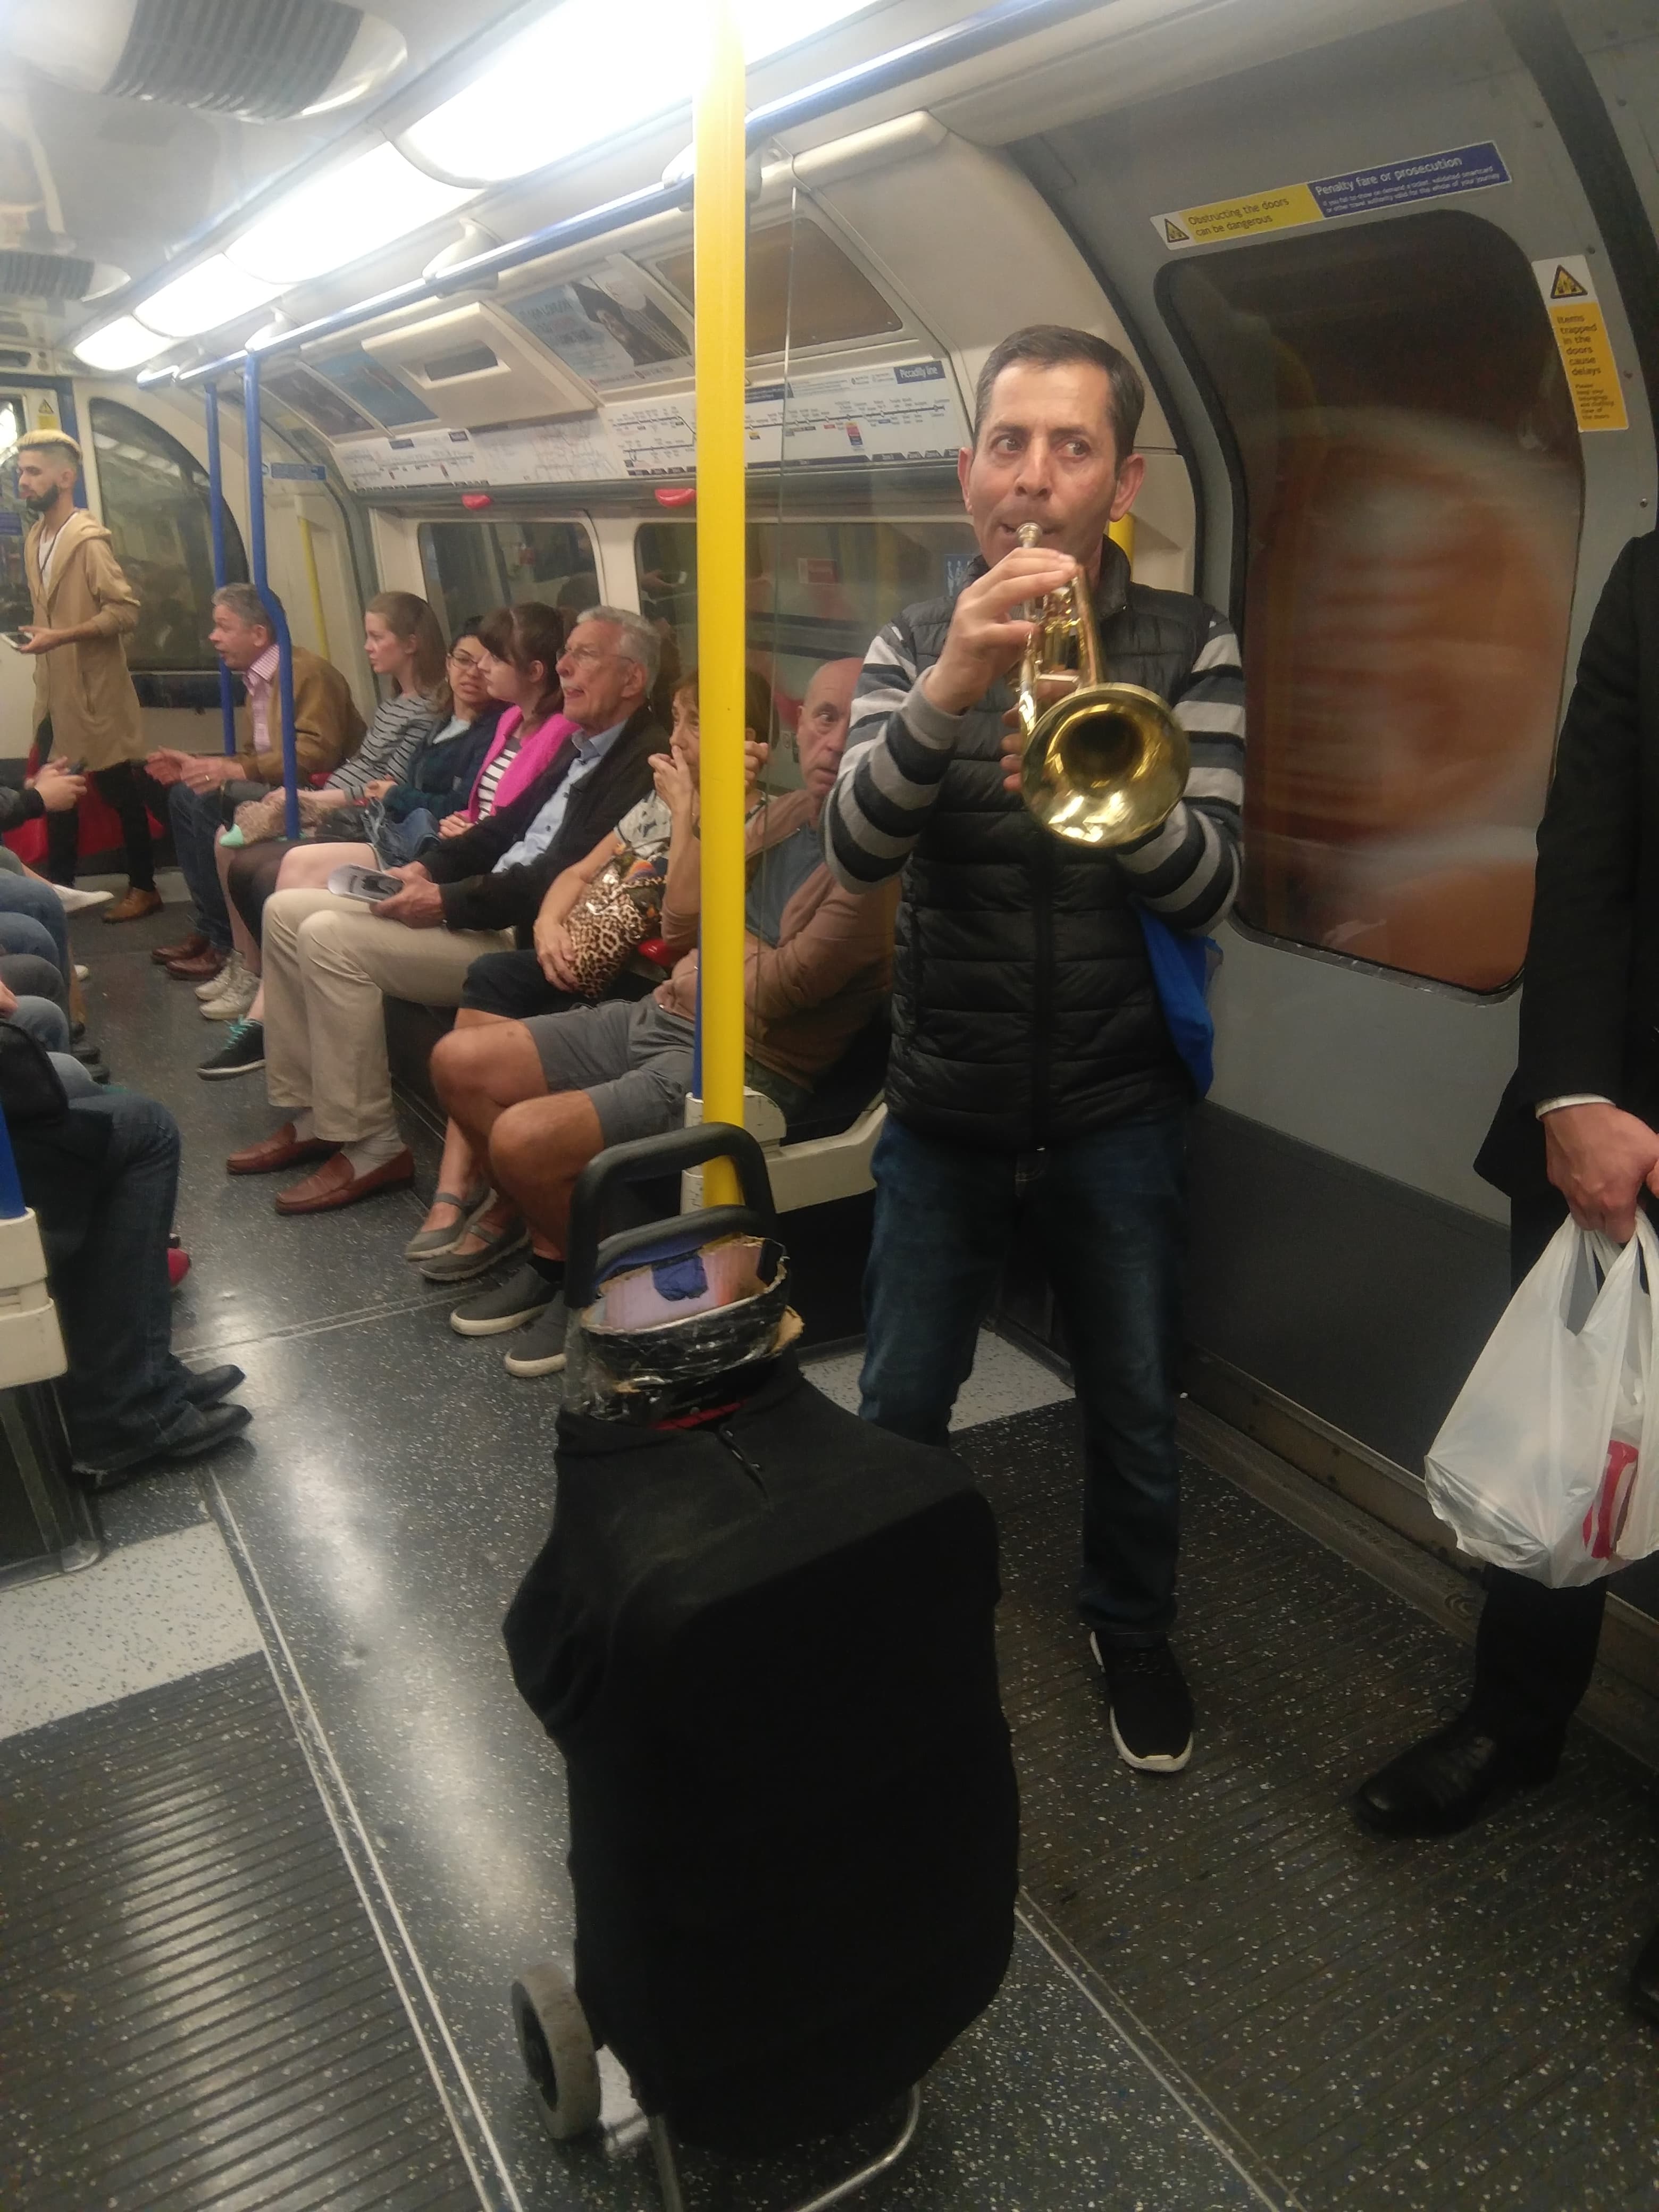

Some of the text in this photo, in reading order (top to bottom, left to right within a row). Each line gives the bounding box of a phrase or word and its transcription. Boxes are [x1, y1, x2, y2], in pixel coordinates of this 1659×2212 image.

[1315, 157, 1462, 195] Penalty fare or prosecution
[1188, 198, 1289, 225] Obstructing the doors
[1195, 215, 1272, 236] can be dangerous
[1556, 315, 1585, 324] Items
[1560, 323, 1598, 334] trapped
[1566, 346, 1594, 355] doors
[1569, 357, 1596, 366] cause
[1571, 367, 1602, 376] delays
